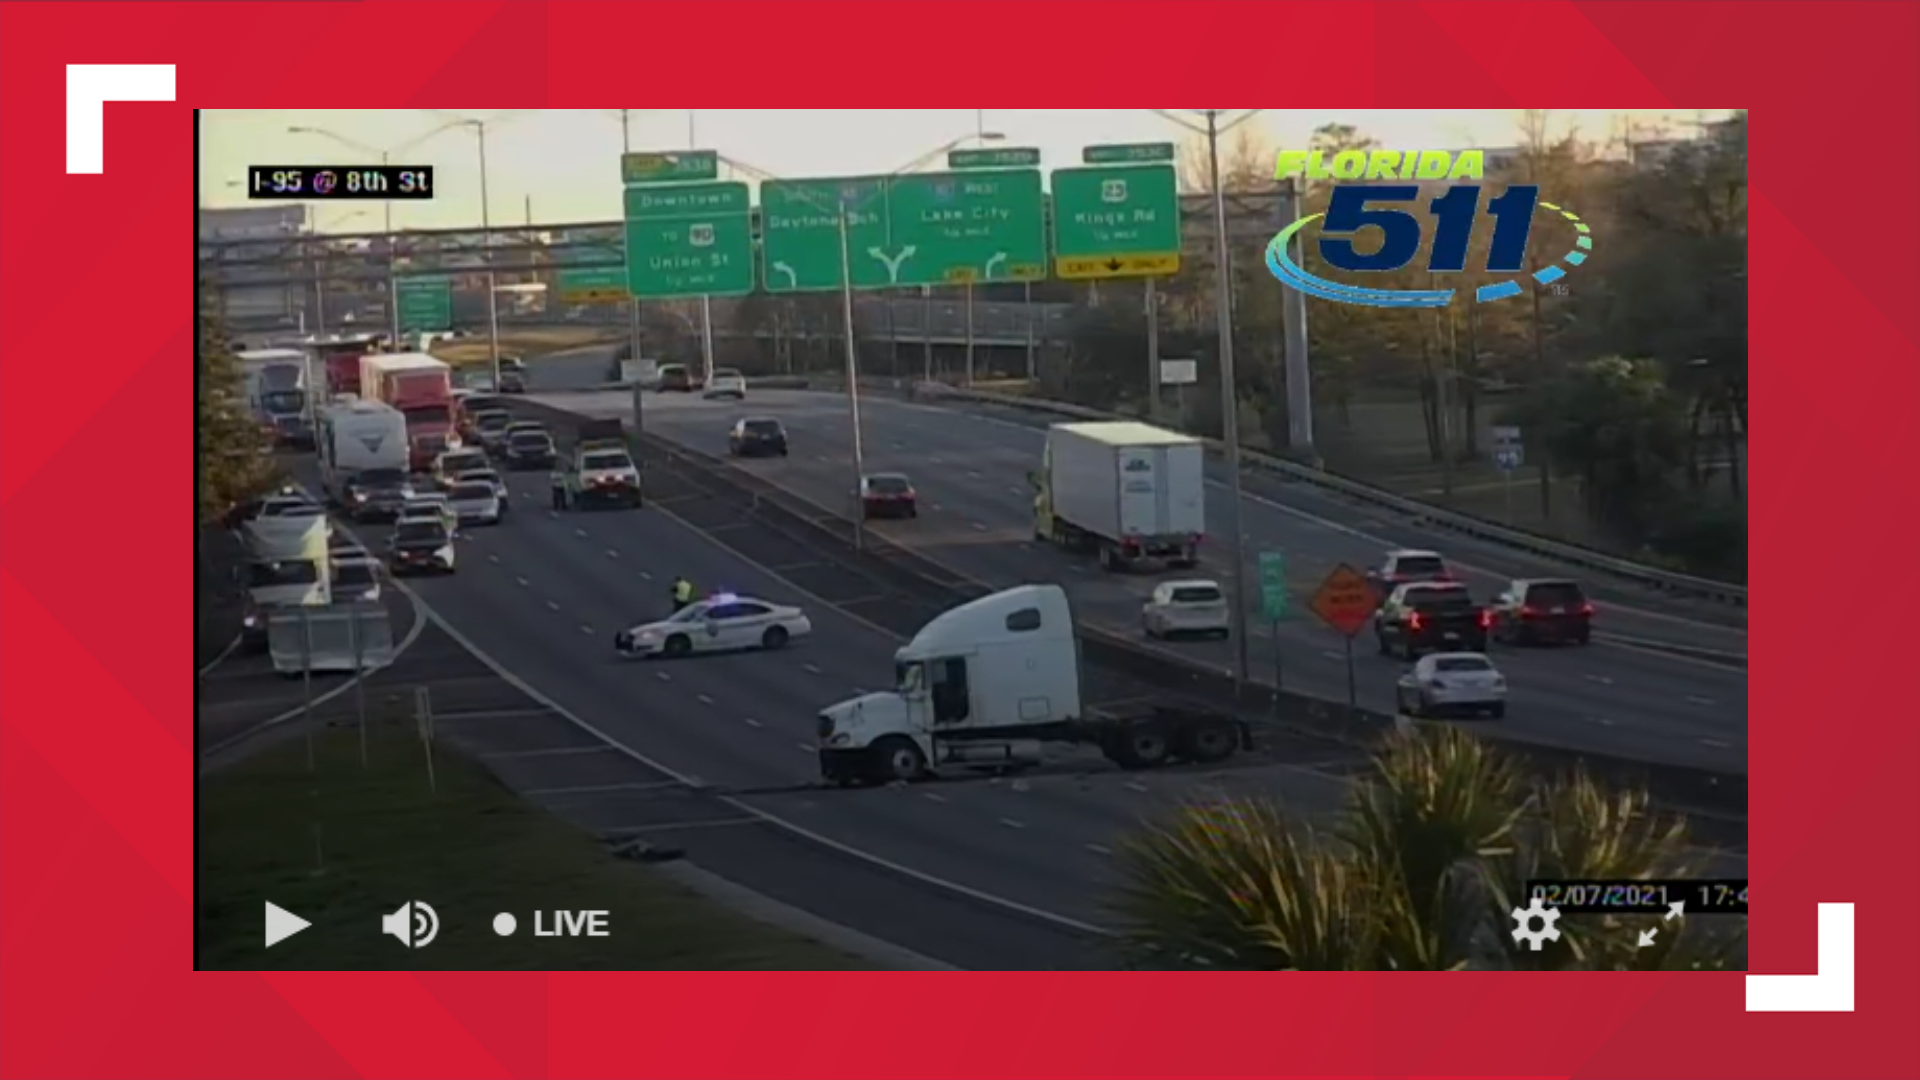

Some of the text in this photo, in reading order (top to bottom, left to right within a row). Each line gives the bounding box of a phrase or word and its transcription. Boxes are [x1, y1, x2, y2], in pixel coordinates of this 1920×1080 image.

[641, 192, 731, 207] Downtown
[921, 206, 1010, 221] Lake City
[1075, 208, 1156, 226] Kings Rd
[770, 214, 839, 230] Daytona
[693, 226, 712, 241] 90
[649, 252, 728, 270] Union St
